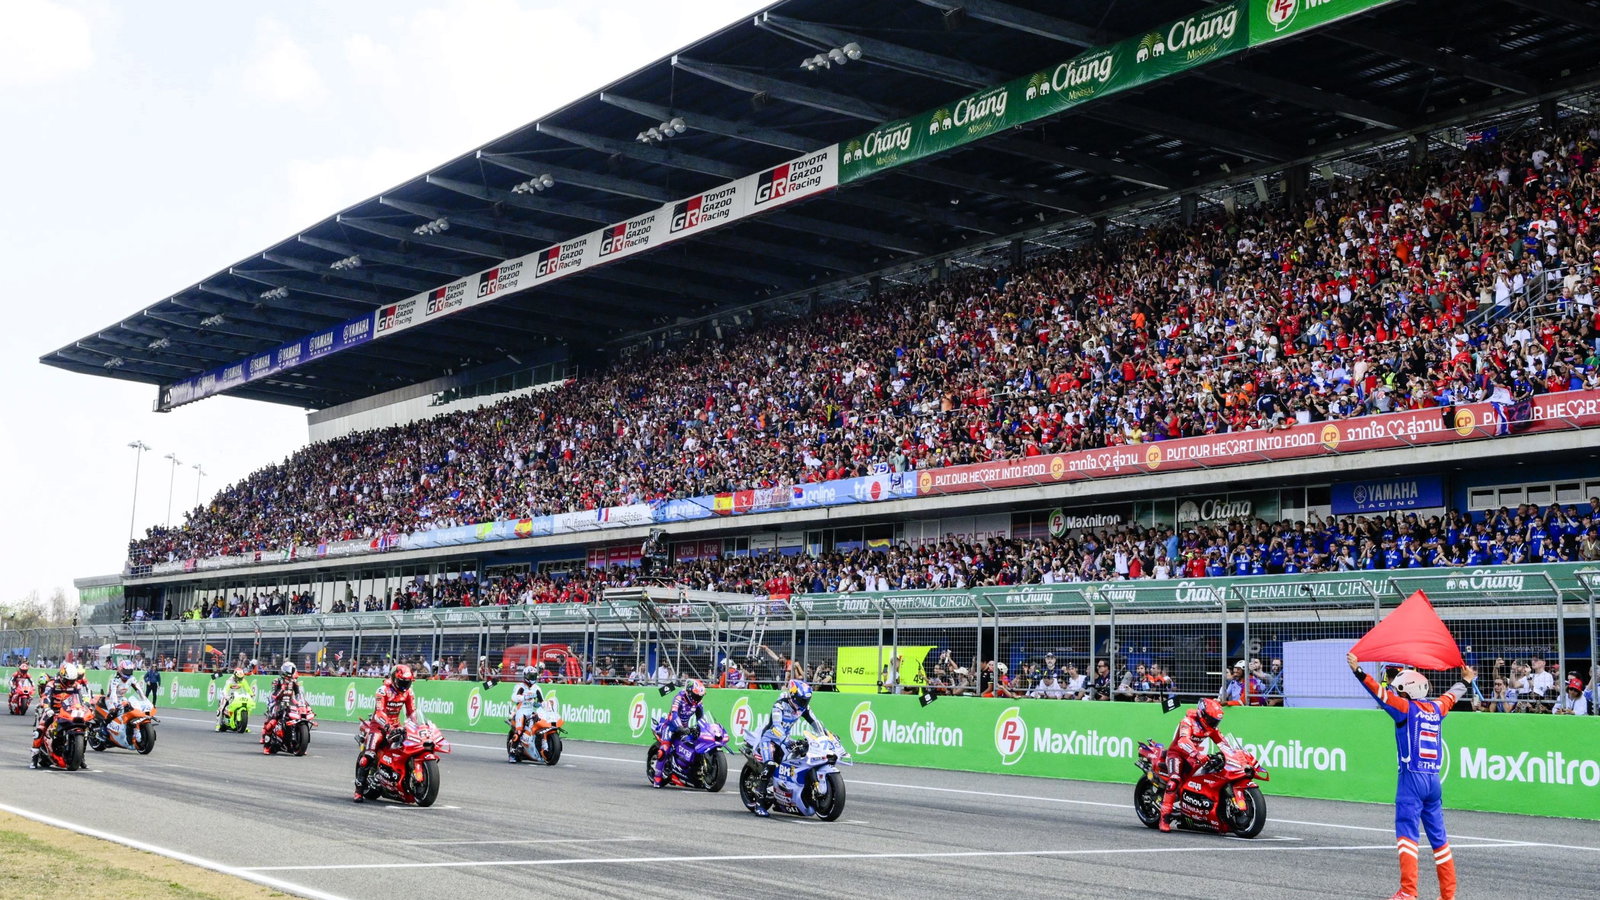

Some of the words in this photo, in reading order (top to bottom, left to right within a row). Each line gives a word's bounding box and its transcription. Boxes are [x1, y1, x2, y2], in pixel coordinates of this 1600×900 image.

[1167, 9, 1238, 52] Chang
[1052, 54, 1114, 92] Chang
[954, 91, 1008, 126] Chang
[864, 126, 912, 158] Chang
[792, 152, 828, 172] TOYOTA
[790, 164, 823, 182] GAZOO
[788, 175, 822, 193] Racing
[704, 187, 736, 203] TOYOTA
[702, 198, 732, 213] GAZOO
[628, 215, 655, 229] TOYOTA
[700, 208, 730, 223] Racing
[626, 226, 651, 239] GAZOO
[561, 239, 587, 252] TOYOTA
[624, 236, 649, 249] Racing
[348, 318, 369, 338] YAMAHA
[315, 332, 333, 349] YAMAHA
[283, 343, 301, 360] YAMAHA
[1456, 416, 1472, 428] CP
[1324, 432, 1337, 442] CP
[1167, 447, 1187, 460] PUT
[1189, 444, 1210, 457] OUR
[1257, 436, 1282, 450] INTO
[1285, 433, 1315, 447] FOOD
[1149, 452, 1159, 460] CP
[936, 474, 950, 485] PUT
[950, 472, 968, 484] OUR
[1002, 466, 1022, 478] INTO
[1023, 464, 1045, 476] FOOD
[1052, 463, 1062, 472] CP
[808, 487, 835, 503] online
[1367, 481, 1418, 501] YAMAHA
[1358, 500, 1415, 509] RACING
[1470, 569, 1524, 591] Chang
[562, 704, 610, 724] Maxnitron
[634, 704, 644, 728] PT
[857, 714, 872, 743] PT
[882, 719, 963, 747] Maxnitron
[1002, 720, 1020, 752] PT
[1034, 727, 1133, 758] Maxnitron
